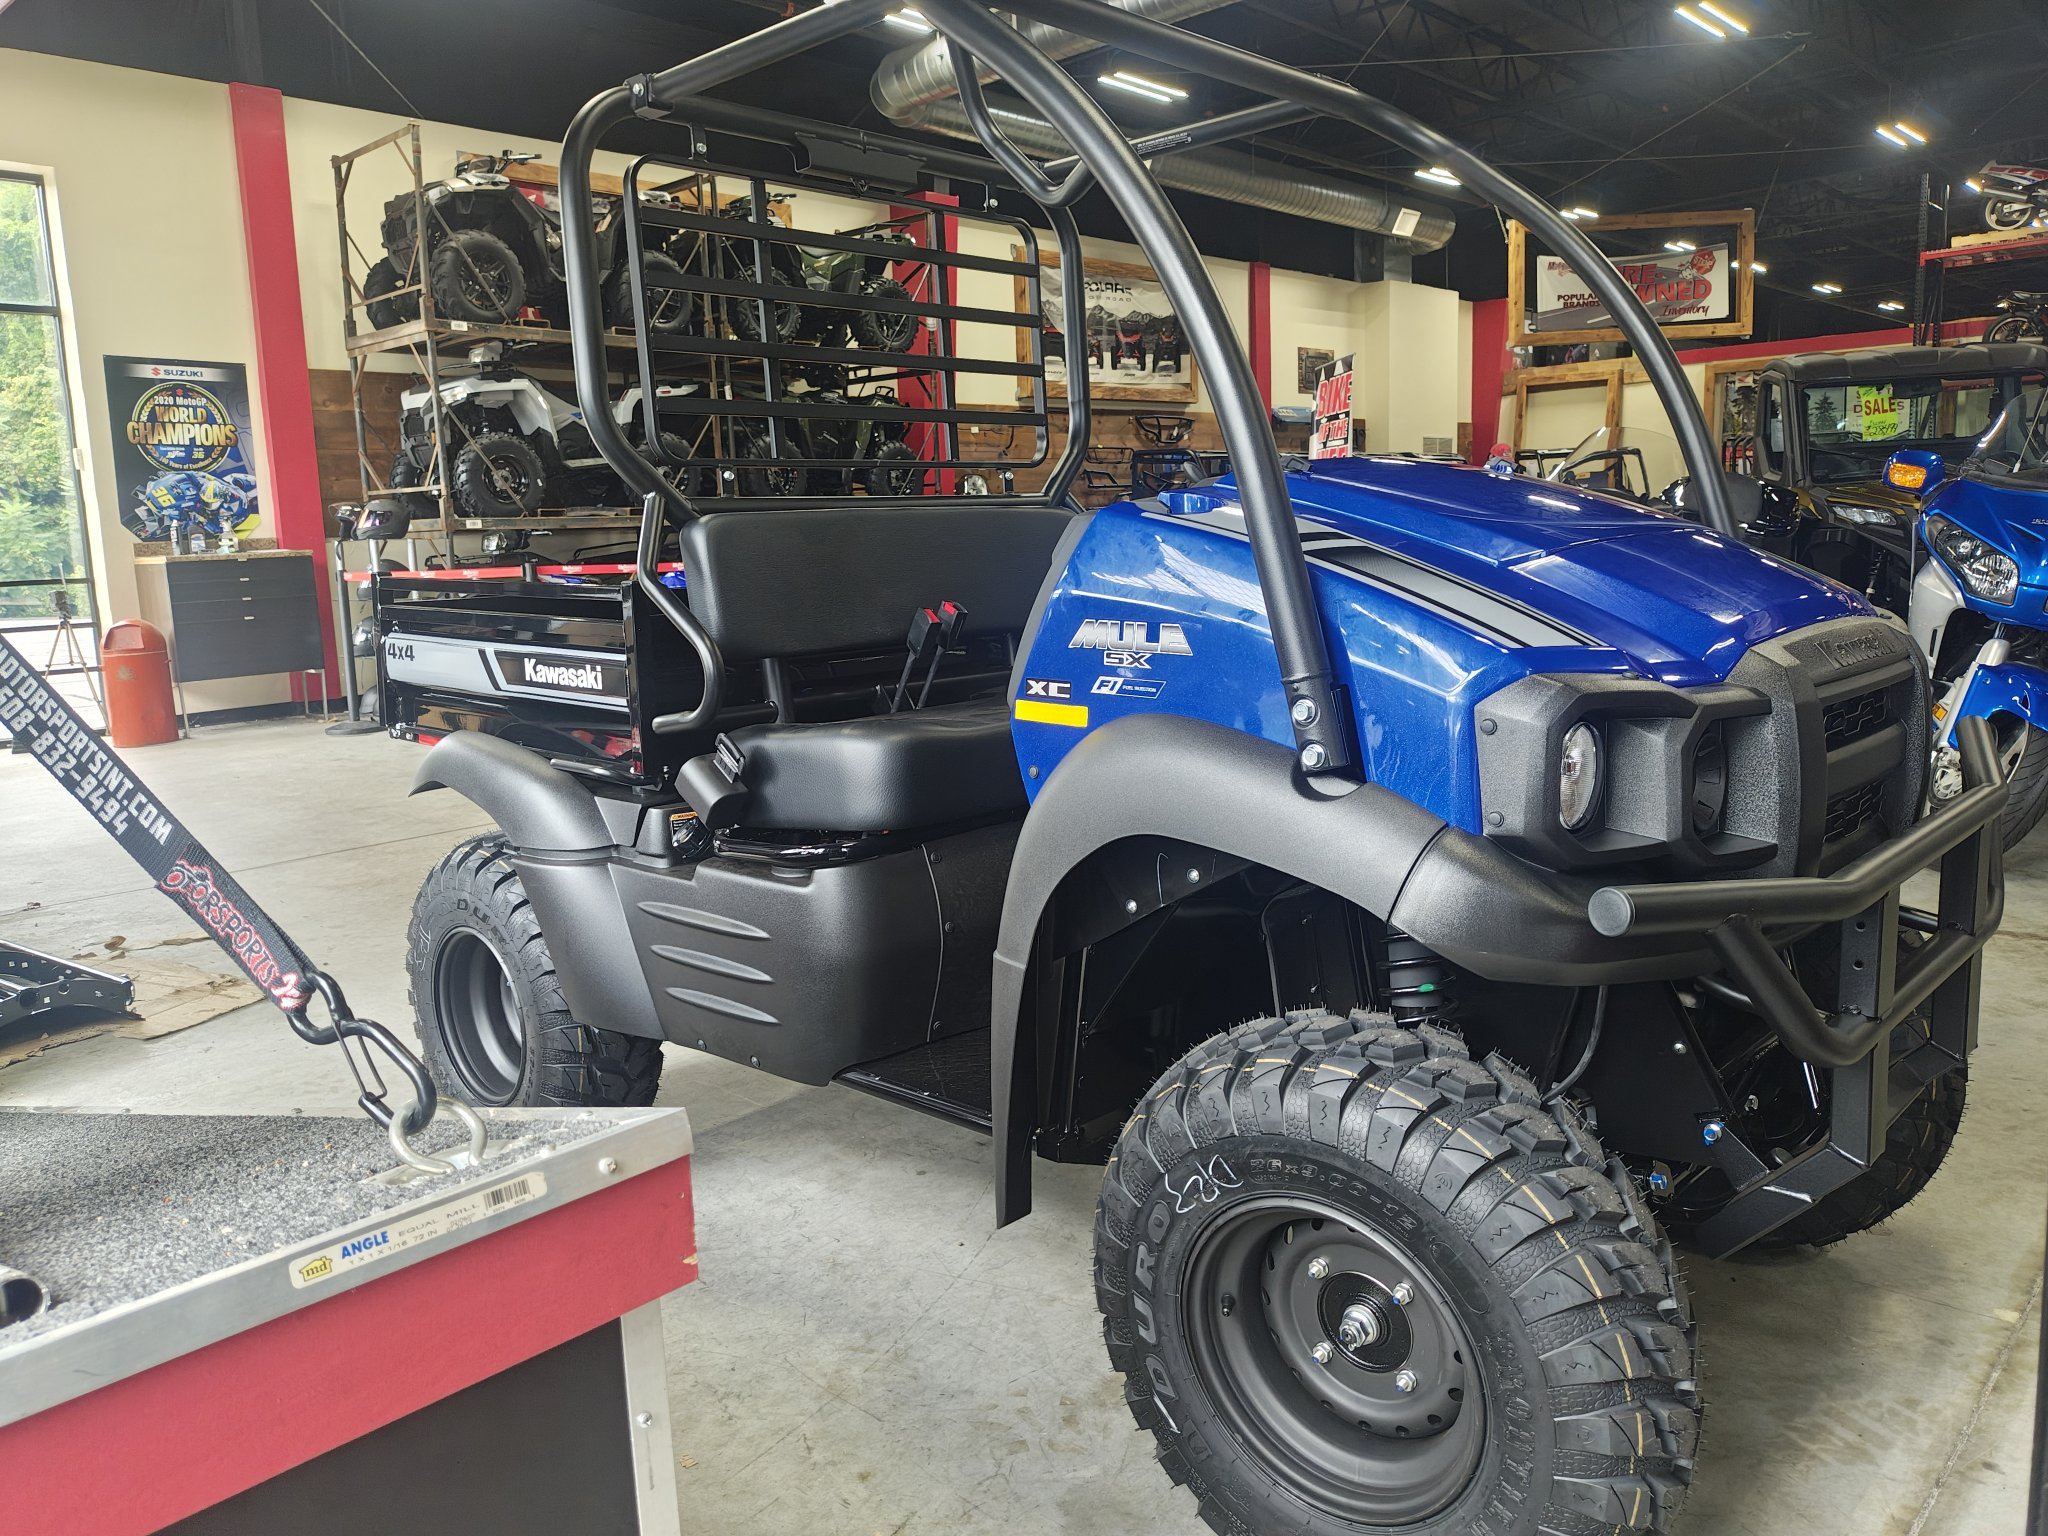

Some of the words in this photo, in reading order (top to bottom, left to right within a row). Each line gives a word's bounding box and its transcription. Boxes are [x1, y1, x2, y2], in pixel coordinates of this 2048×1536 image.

[1615, 264, 1664, 285] RE-
[1634, 279, 1713, 305] WNED
[1563, 300, 1601, 308] BRANDS
[1661, 304, 1709, 317] Inventory
[163, 369, 204, 378] SUZUKI
[154, 396, 174, 405] 2020
[176, 397, 207, 406] MotoGP
[1315, 371, 1353, 419] BIKE
[154, 406, 208, 424] WORLD
[1864, 396, 1896, 416] SALE
[126, 422, 238, 447] CHAMPIONS
[151, 486, 176, 508] 36
[1068, 619, 1194, 656] MULE
[387, 642, 416, 662] 4x4
[1104, 651, 1153, 669] SX
[523, 657, 604, 691] Kawasaki
[1026, 679, 1071, 699] XC
[341, 1230, 390, 1260] ANGLE
[398, 1218, 440, 1238] EQUAL
[446, 1203, 480, 1219] MILL
[305, 1261, 329, 1278] md
[1131, 1199, 1181, 1402] DURO
